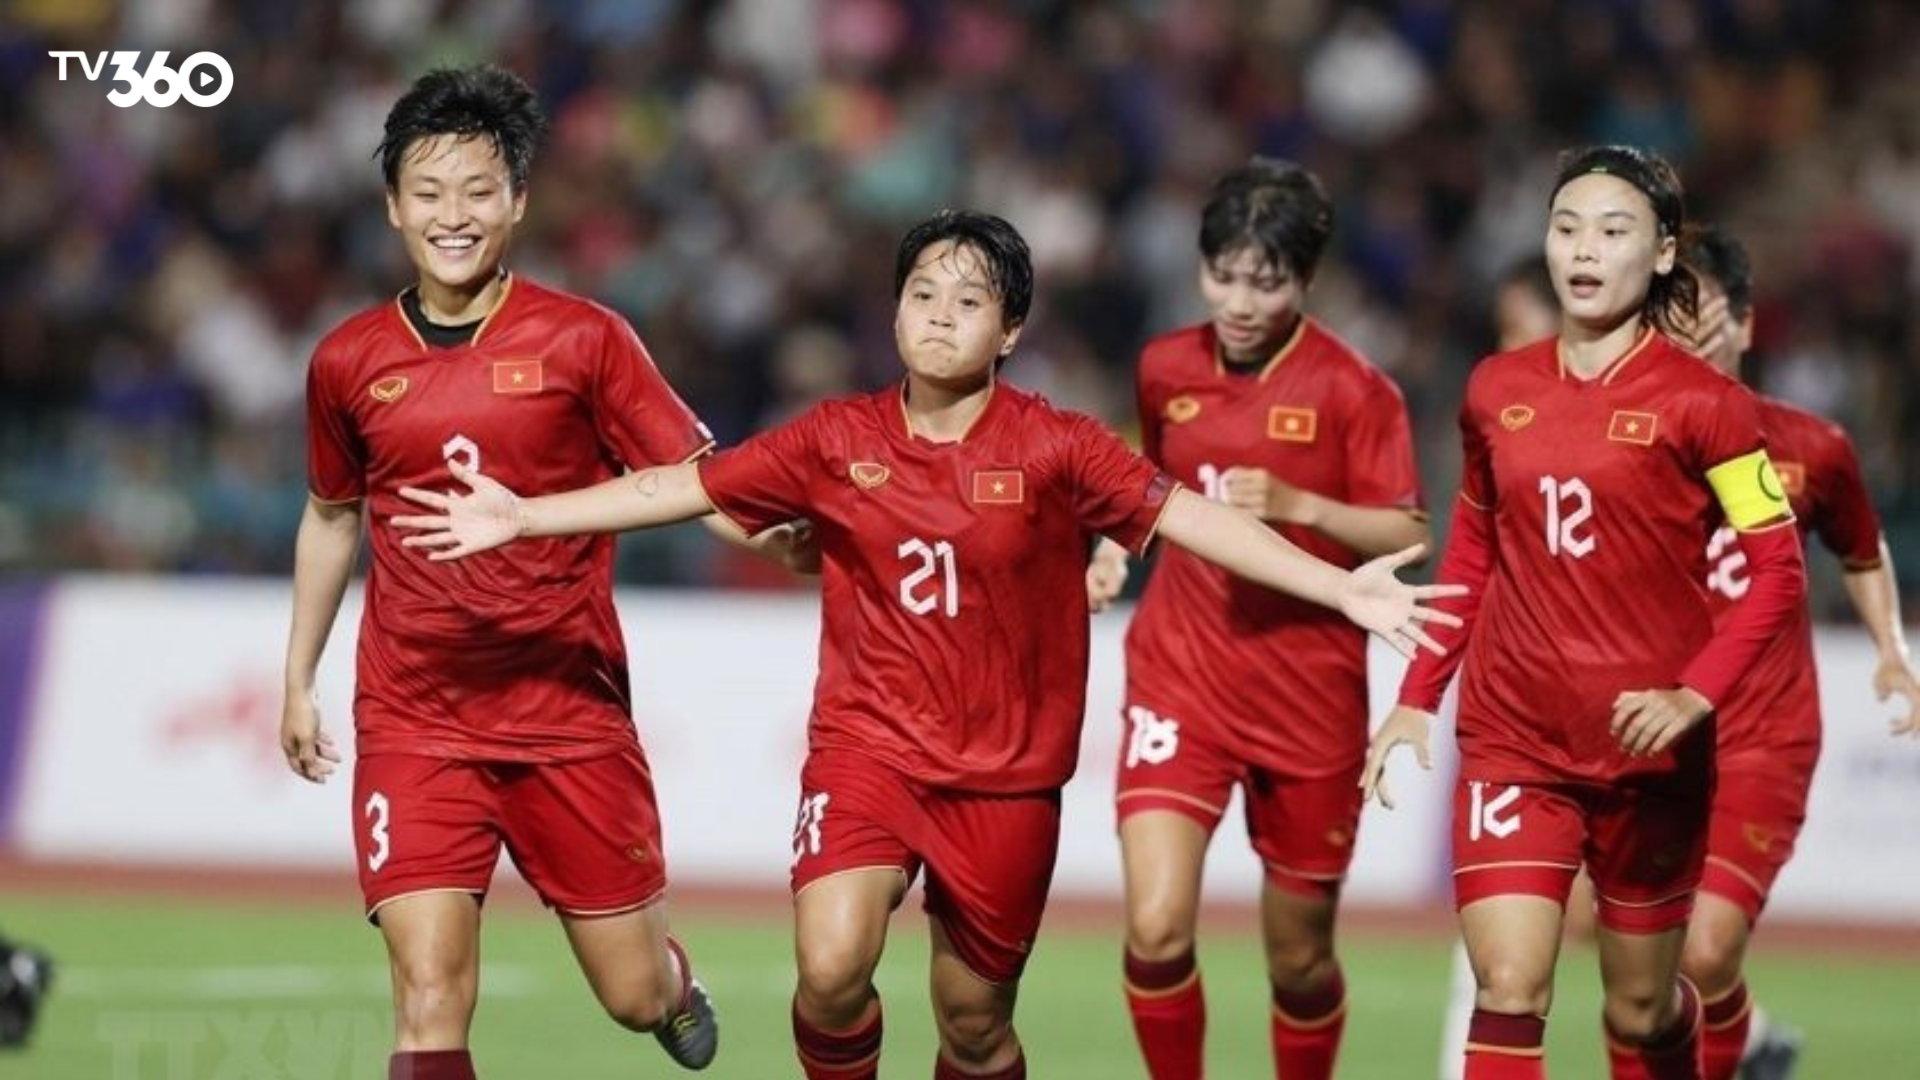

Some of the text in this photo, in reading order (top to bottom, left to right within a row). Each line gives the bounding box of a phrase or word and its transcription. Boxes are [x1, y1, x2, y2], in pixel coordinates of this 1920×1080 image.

[1540, 475, 1595, 558] 12
[898, 537, 958, 617] 21
[365, 792, 389, 872] 3
[1468, 781, 1521, 841] 12
